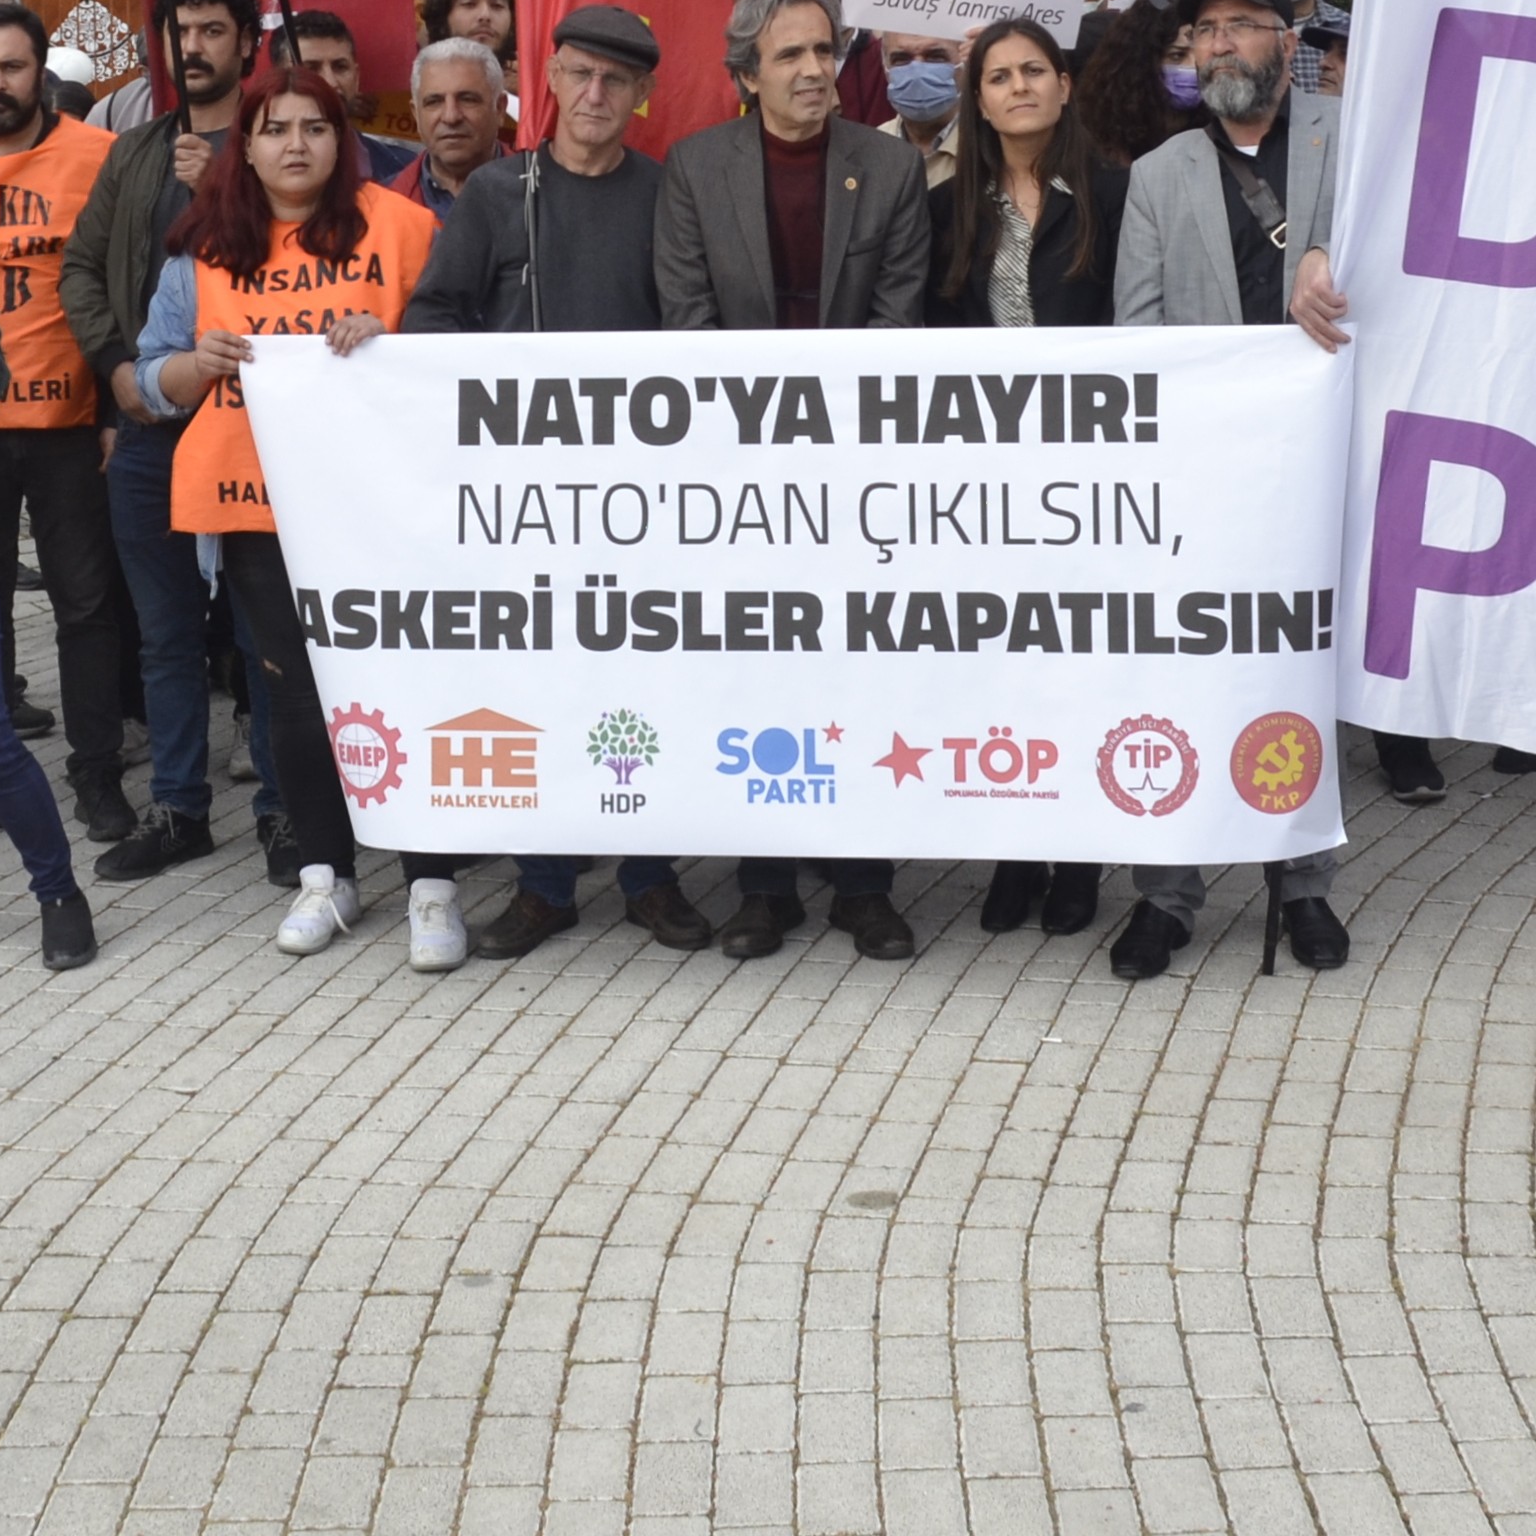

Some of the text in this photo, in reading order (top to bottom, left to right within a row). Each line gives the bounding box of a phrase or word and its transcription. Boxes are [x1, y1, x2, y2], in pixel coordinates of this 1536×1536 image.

[1021, 2, 1065, 24] Ares
[458, 373, 1158, 446] NATO'YA HAYIR!
[457, 481, 1182, 564] NATO'DAN ÇIKILSIN,
[296, 574, 1334, 655] ASKERİ ÜSLER KAPATILSIN!
[337, 742, 386, 768] EMEP
[715, 727, 834, 775] SOL
[943, 726, 1059, 785] TÖP
[1124, 738, 1172, 769] TİP
[431, 792, 538, 809] HALKEVLERİ
[601, 793, 646, 814] HDP
[1259, 790, 1300, 810] TKP
